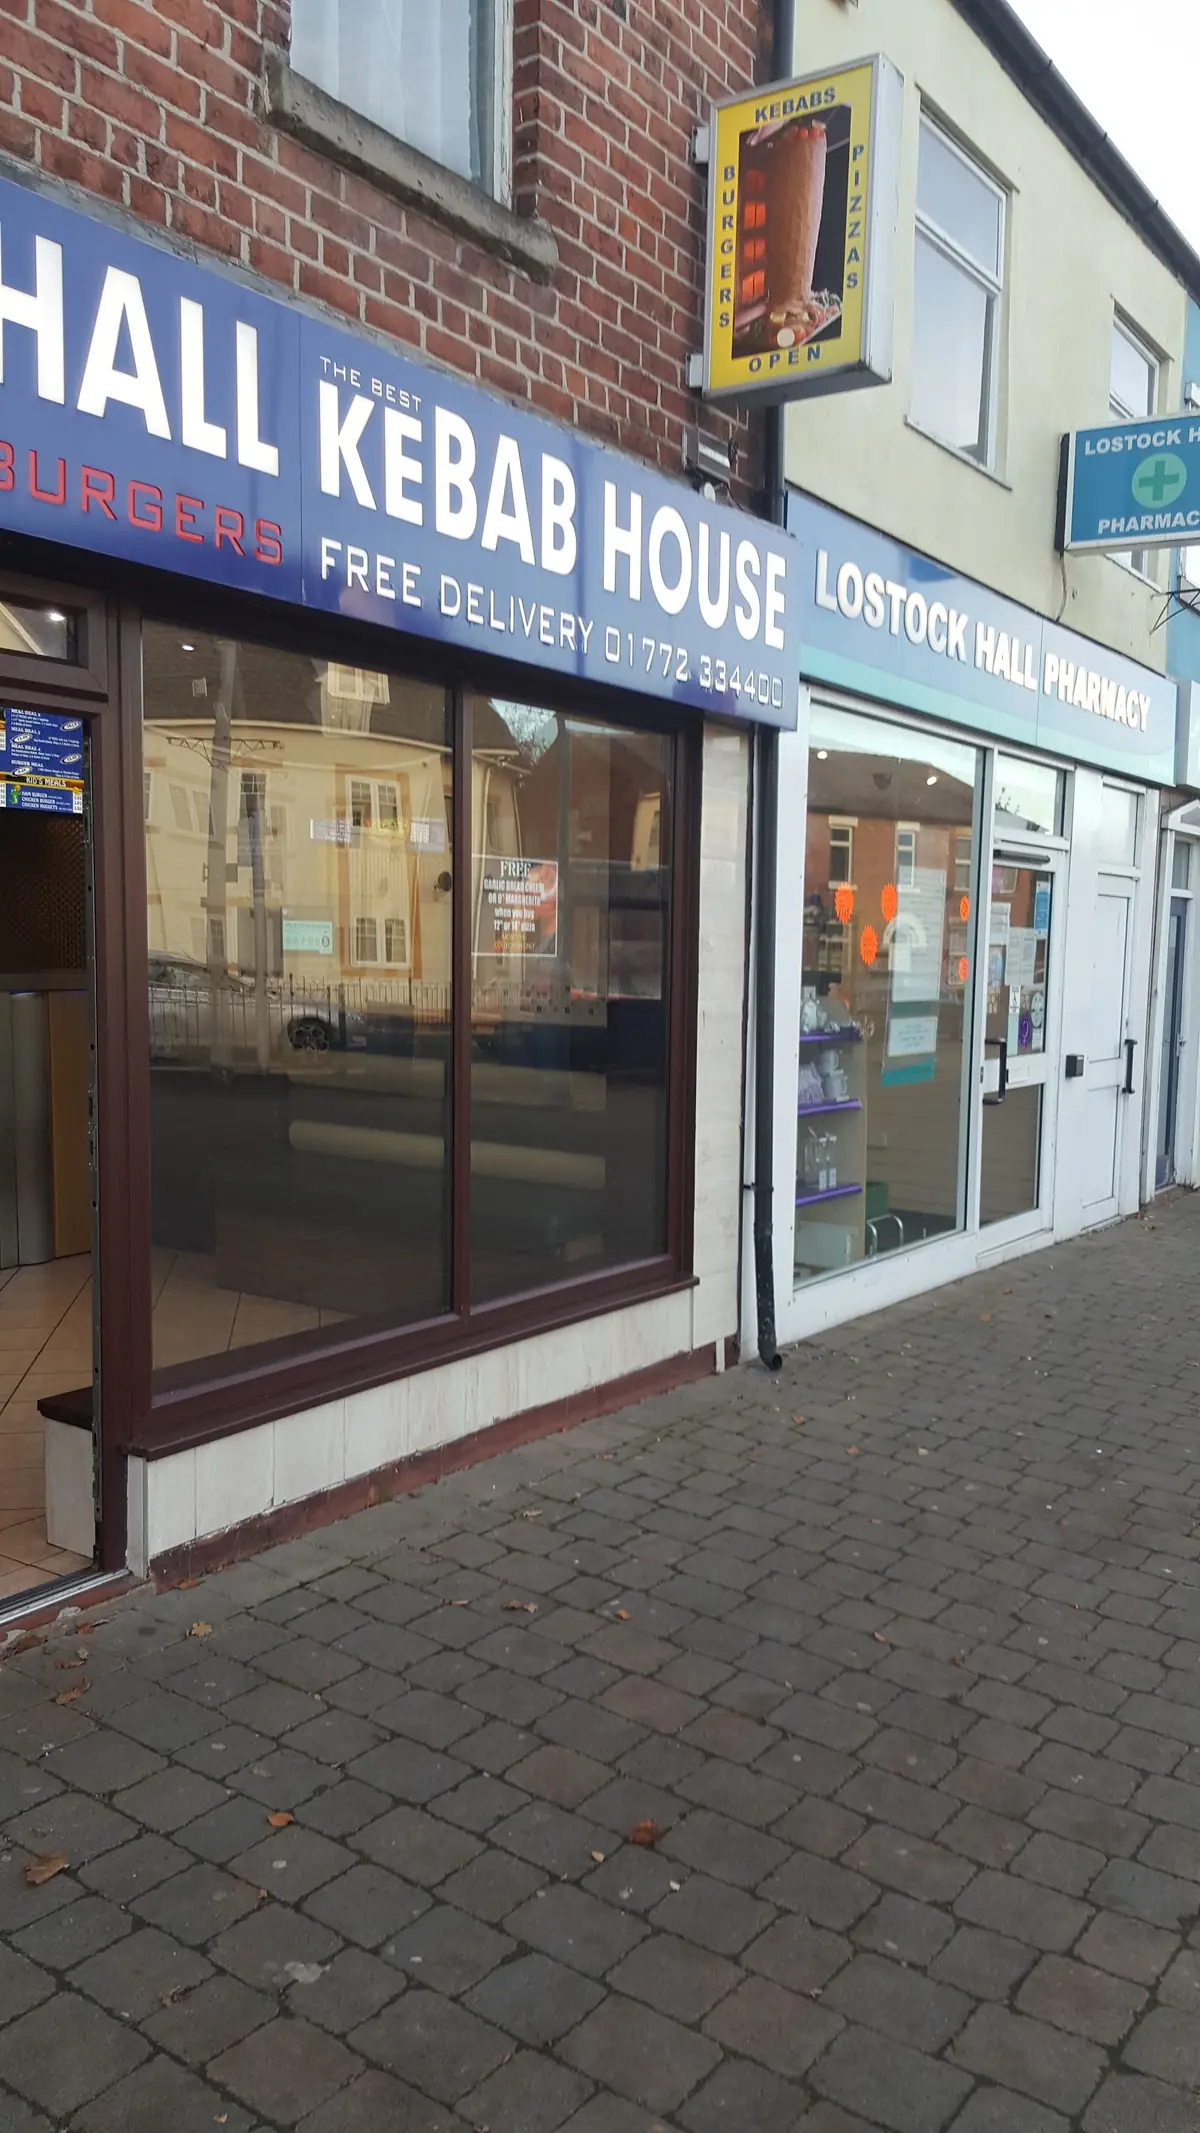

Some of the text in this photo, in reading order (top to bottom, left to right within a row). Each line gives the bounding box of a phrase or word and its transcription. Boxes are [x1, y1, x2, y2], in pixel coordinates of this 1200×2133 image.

[755, 87, 836, 124] KEBABS
[846, 144, 865, 289] PIZZAS
[719, 165, 736, 328] BURGERS
[748, 344, 821, 373] OPEN
[320, 355, 423, 413] THE BEST
[0, 218, 787, 651] HALL KEBAB HOUSE
[1085, 428, 1182, 456] LOSTOCK
[321, 536, 784, 709] FREE DELIVERY 01772 334400
[814, 548, 1152, 732] LOSTOCK HALL PHARMACY
[26, 776, 67, 787] KID'S MEALS
[484, 878, 505, 891] GARLIC
[500, 860, 532, 878] FREE
